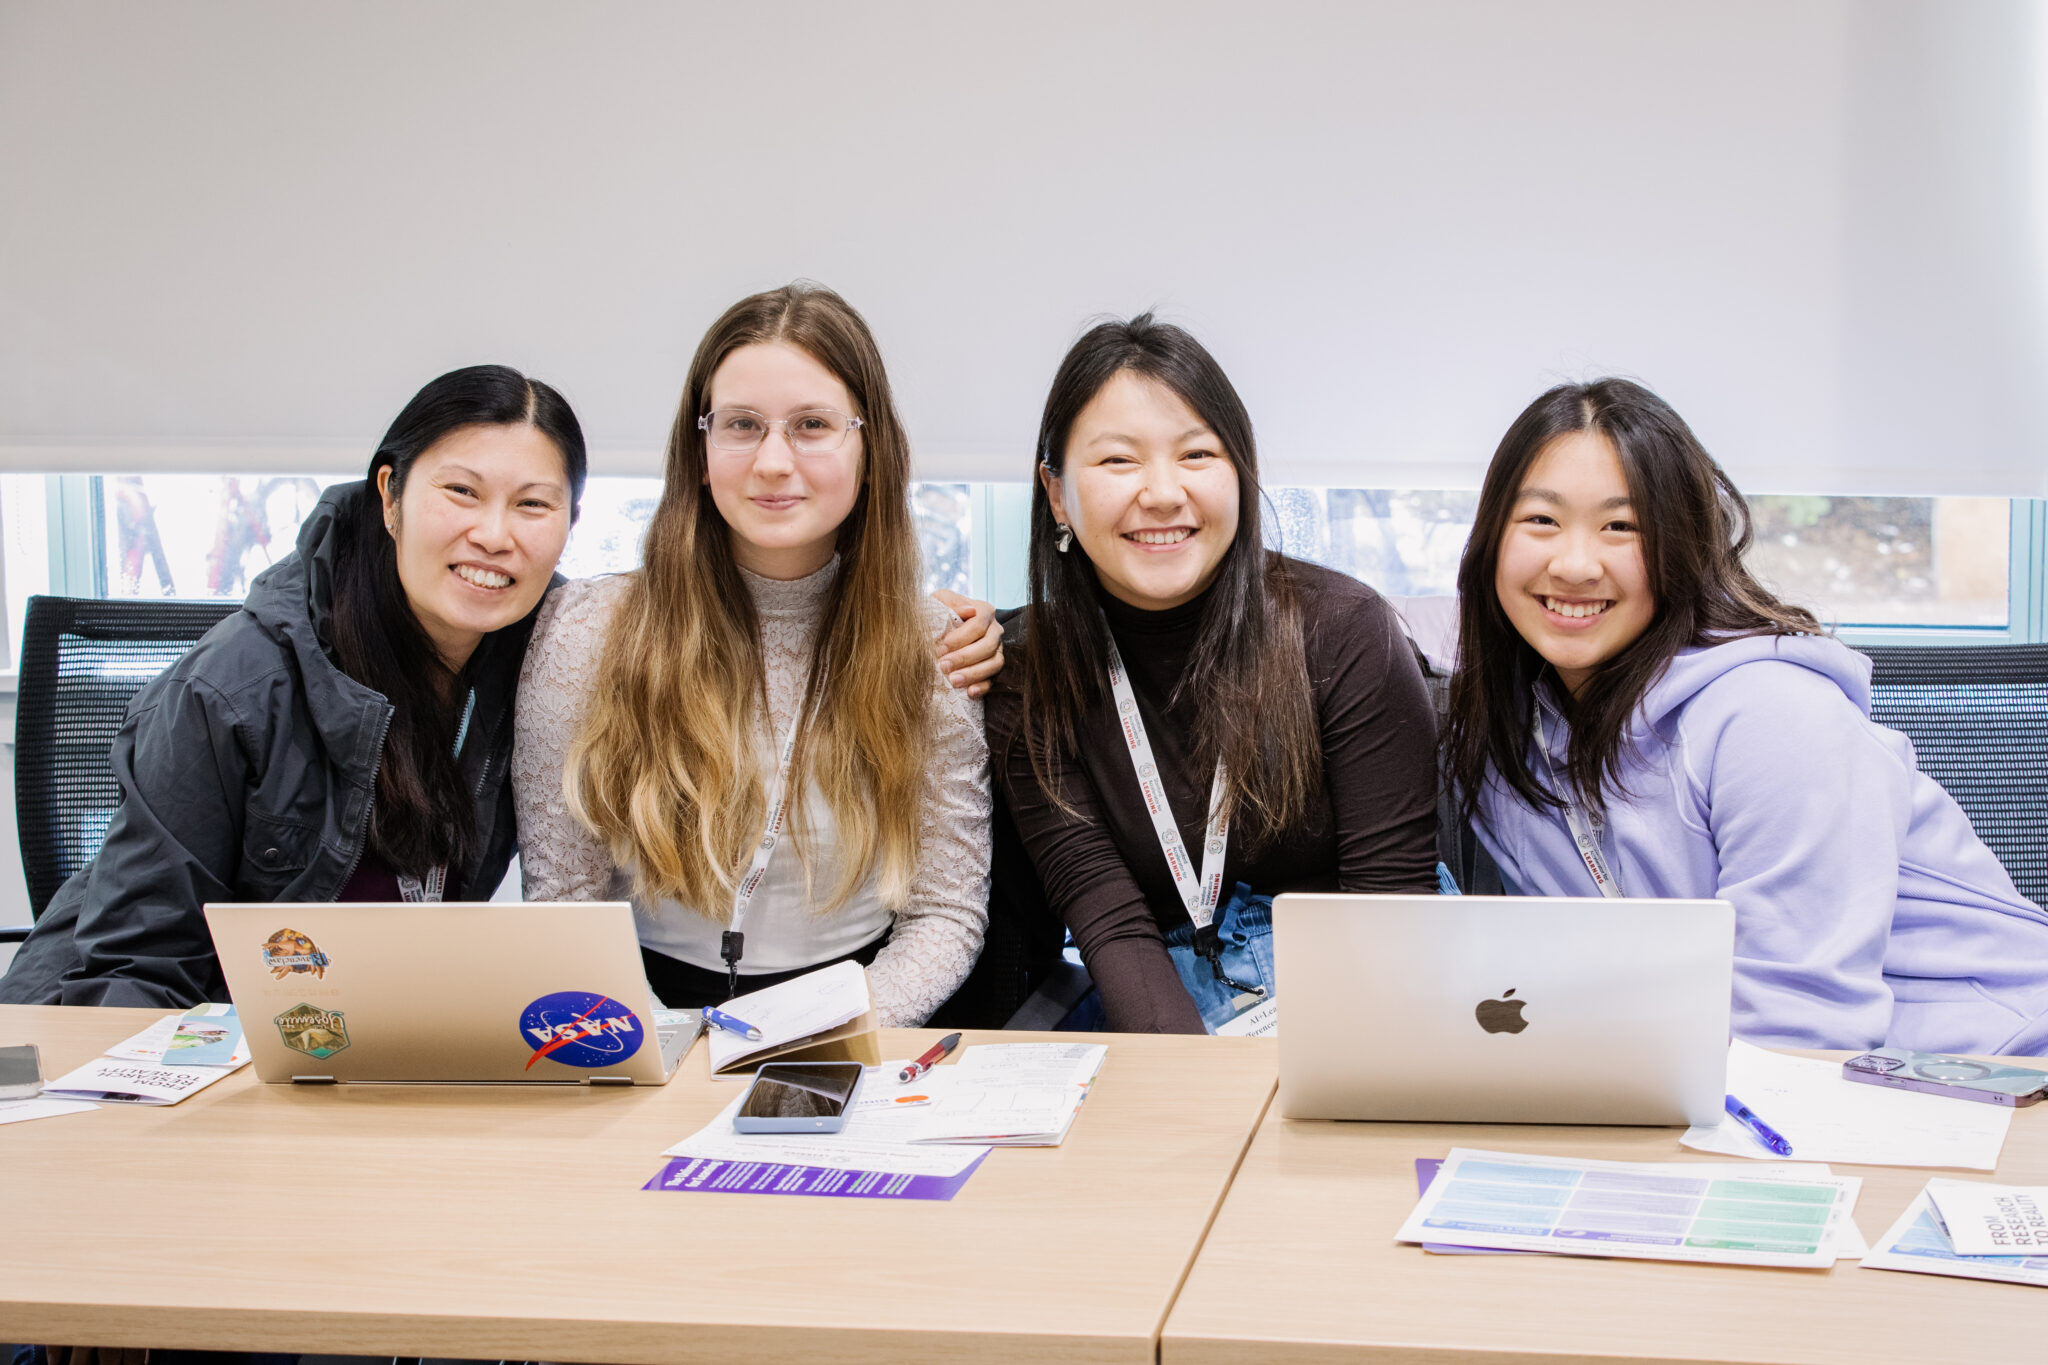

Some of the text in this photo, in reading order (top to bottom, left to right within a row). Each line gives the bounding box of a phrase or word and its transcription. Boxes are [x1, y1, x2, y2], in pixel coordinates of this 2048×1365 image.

[1122, 717, 1137, 749] LEARNING
[1142, 781, 1158, 815] LEARNING
[1166, 848, 1183, 881] LEARNING
[1583, 852, 1604, 884] LEARNING
[1210, 873, 1221, 906] LEARNING
[275, 1011, 344, 1029] Yosemite
[527, 1016, 635, 1043] NASA
[1250, 1007, 1276, 1025] AI+Lea
[97, 1067, 174, 1077] REALITY
[97, 1072, 195, 1086] RESEARCH
[133, 1079, 187, 1090] FROM
[1983, 1215, 2011, 1246] FROM
[1991, 1196, 2033, 1246] RESEARCH
